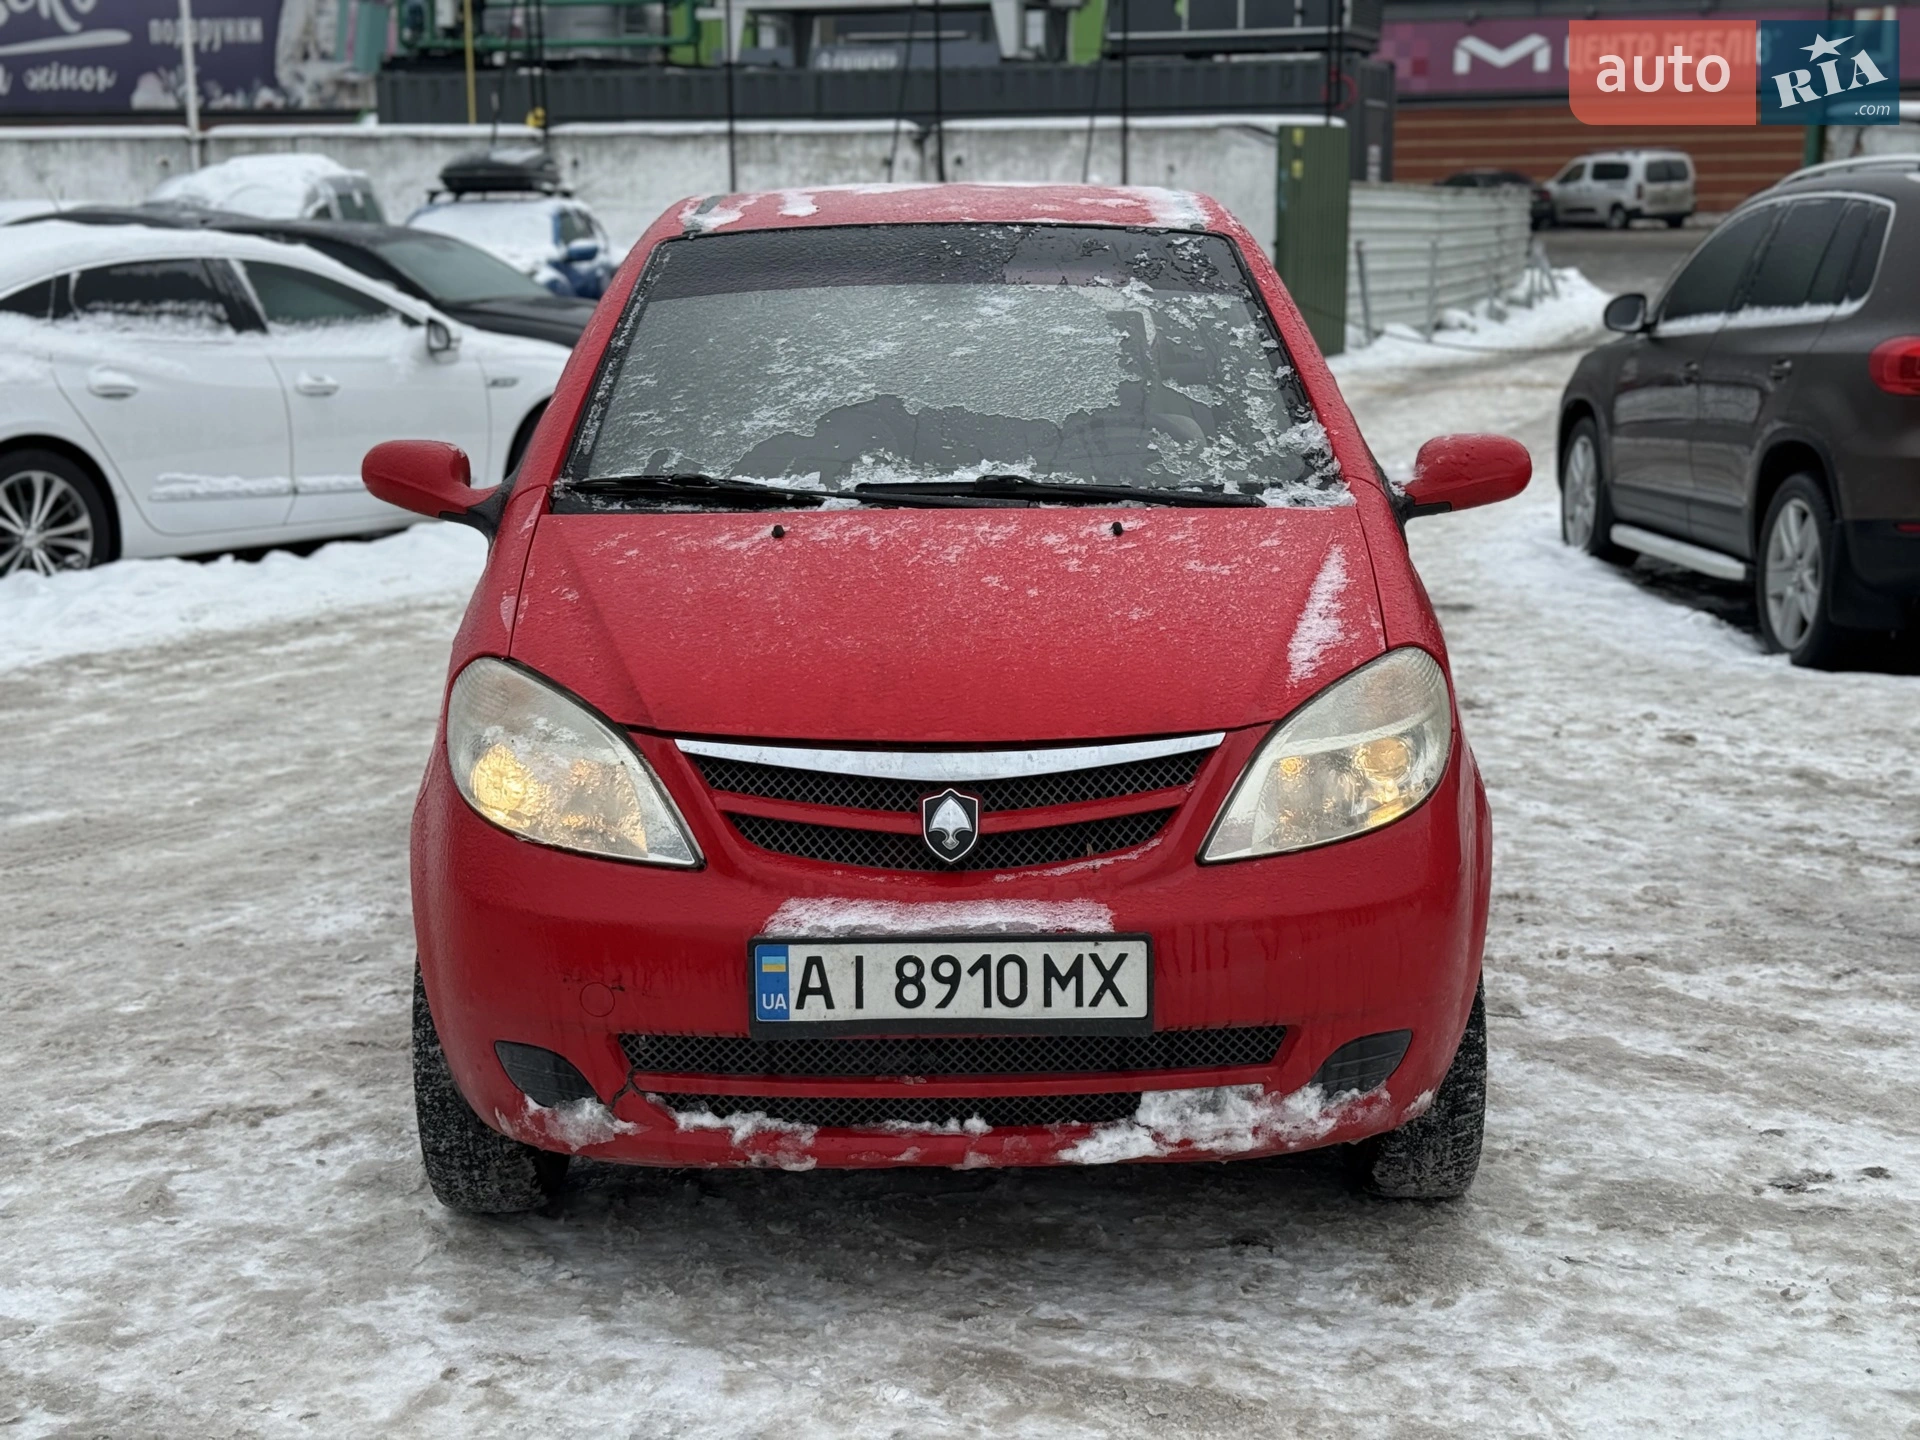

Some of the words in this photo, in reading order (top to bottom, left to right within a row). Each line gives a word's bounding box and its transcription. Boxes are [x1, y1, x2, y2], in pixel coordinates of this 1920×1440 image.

[795, 954, 864, 1010] AI
[894, 953, 1028, 1010] 8910
[1043, 952, 1130, 1008] MX
[762, 993, 788, 1011] UA
